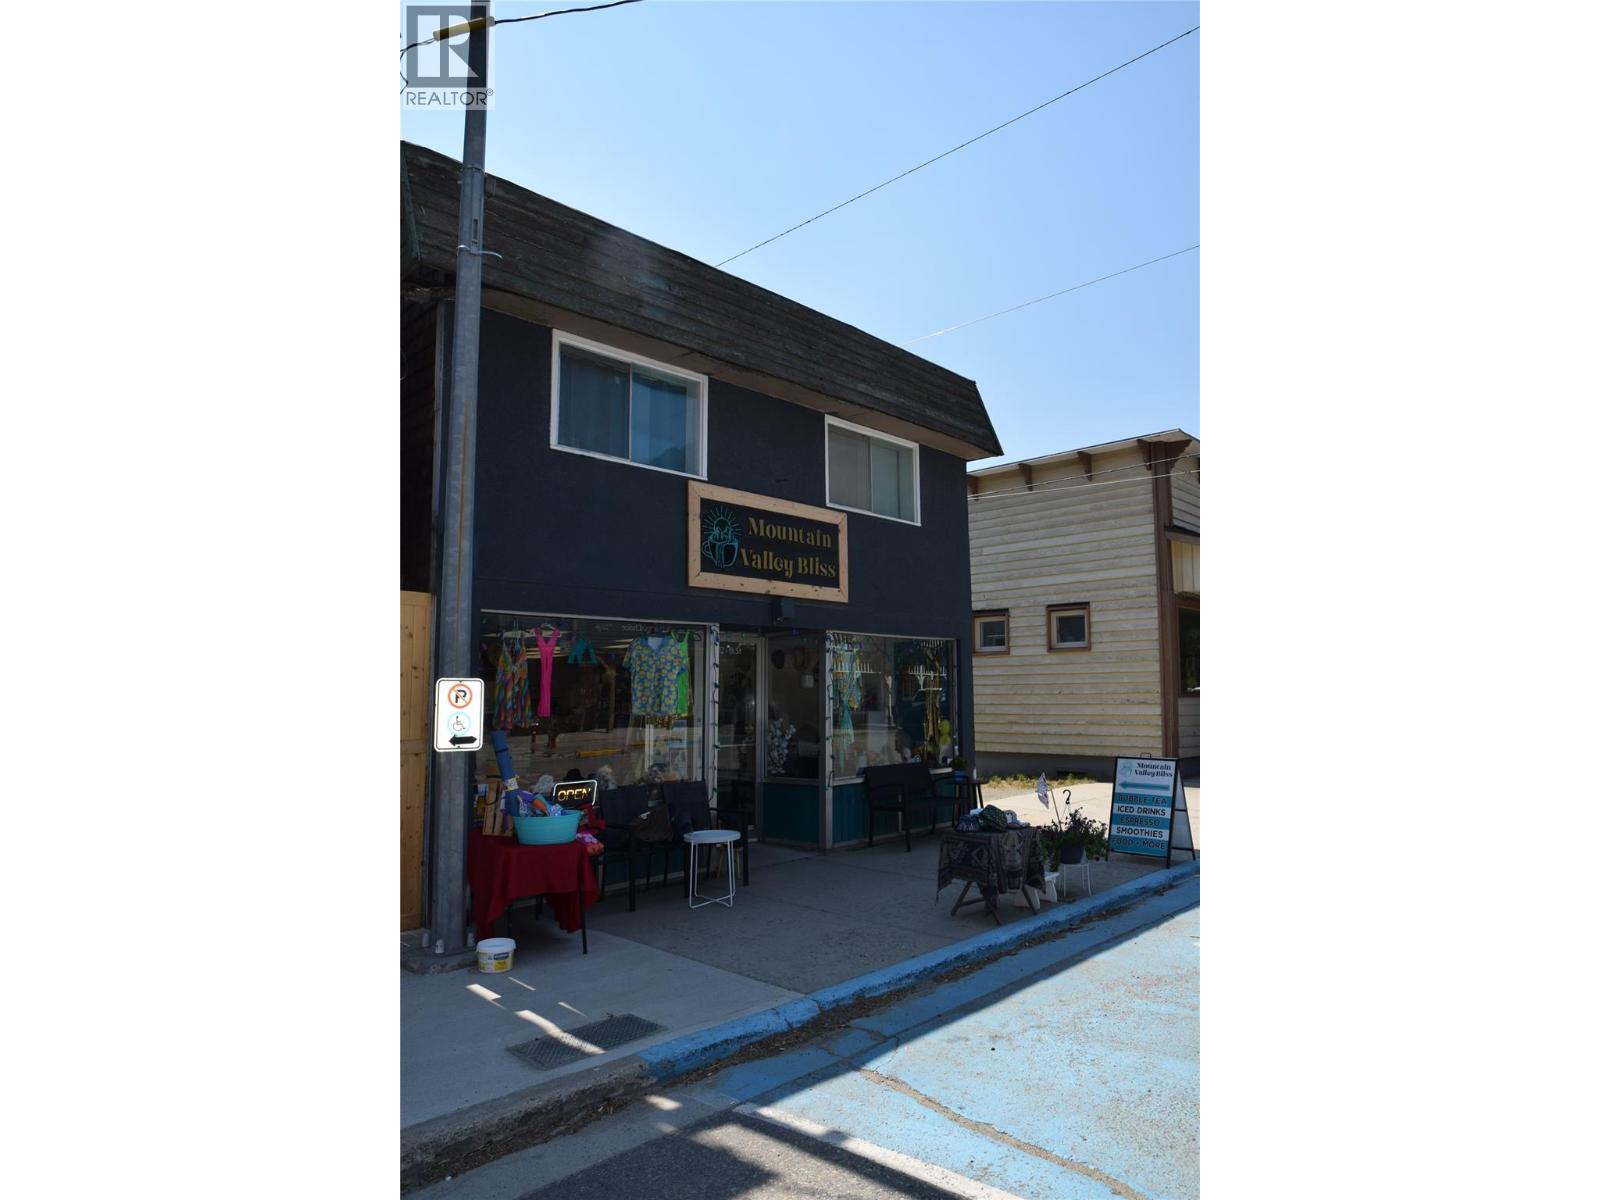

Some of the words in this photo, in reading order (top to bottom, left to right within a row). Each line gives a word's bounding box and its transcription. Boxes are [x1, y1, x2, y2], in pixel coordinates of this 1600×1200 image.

[748, 517, 832, 548] Mountain
[740, 548, 793, 578] Valley
[798, 557, 836, 577] Bliss
[1137, 762, 1171, 770] Mountain
[1135, 769, 1156, 777] Valley
[1156, 769, 1173, 777] Bliss
[558, 788, 591, 801] OPEN
[1152, 796, 1167, 805] TEA
[1117, 805, 1134, 813] ICED
[1137, 806, 1166, 816] DRINKS
[1120, 815, 1160, 826] ESPRESSO
[1116, 827, 1163, 838] SMOOTHIES
[1143, 840, 1165, 849] MORE
